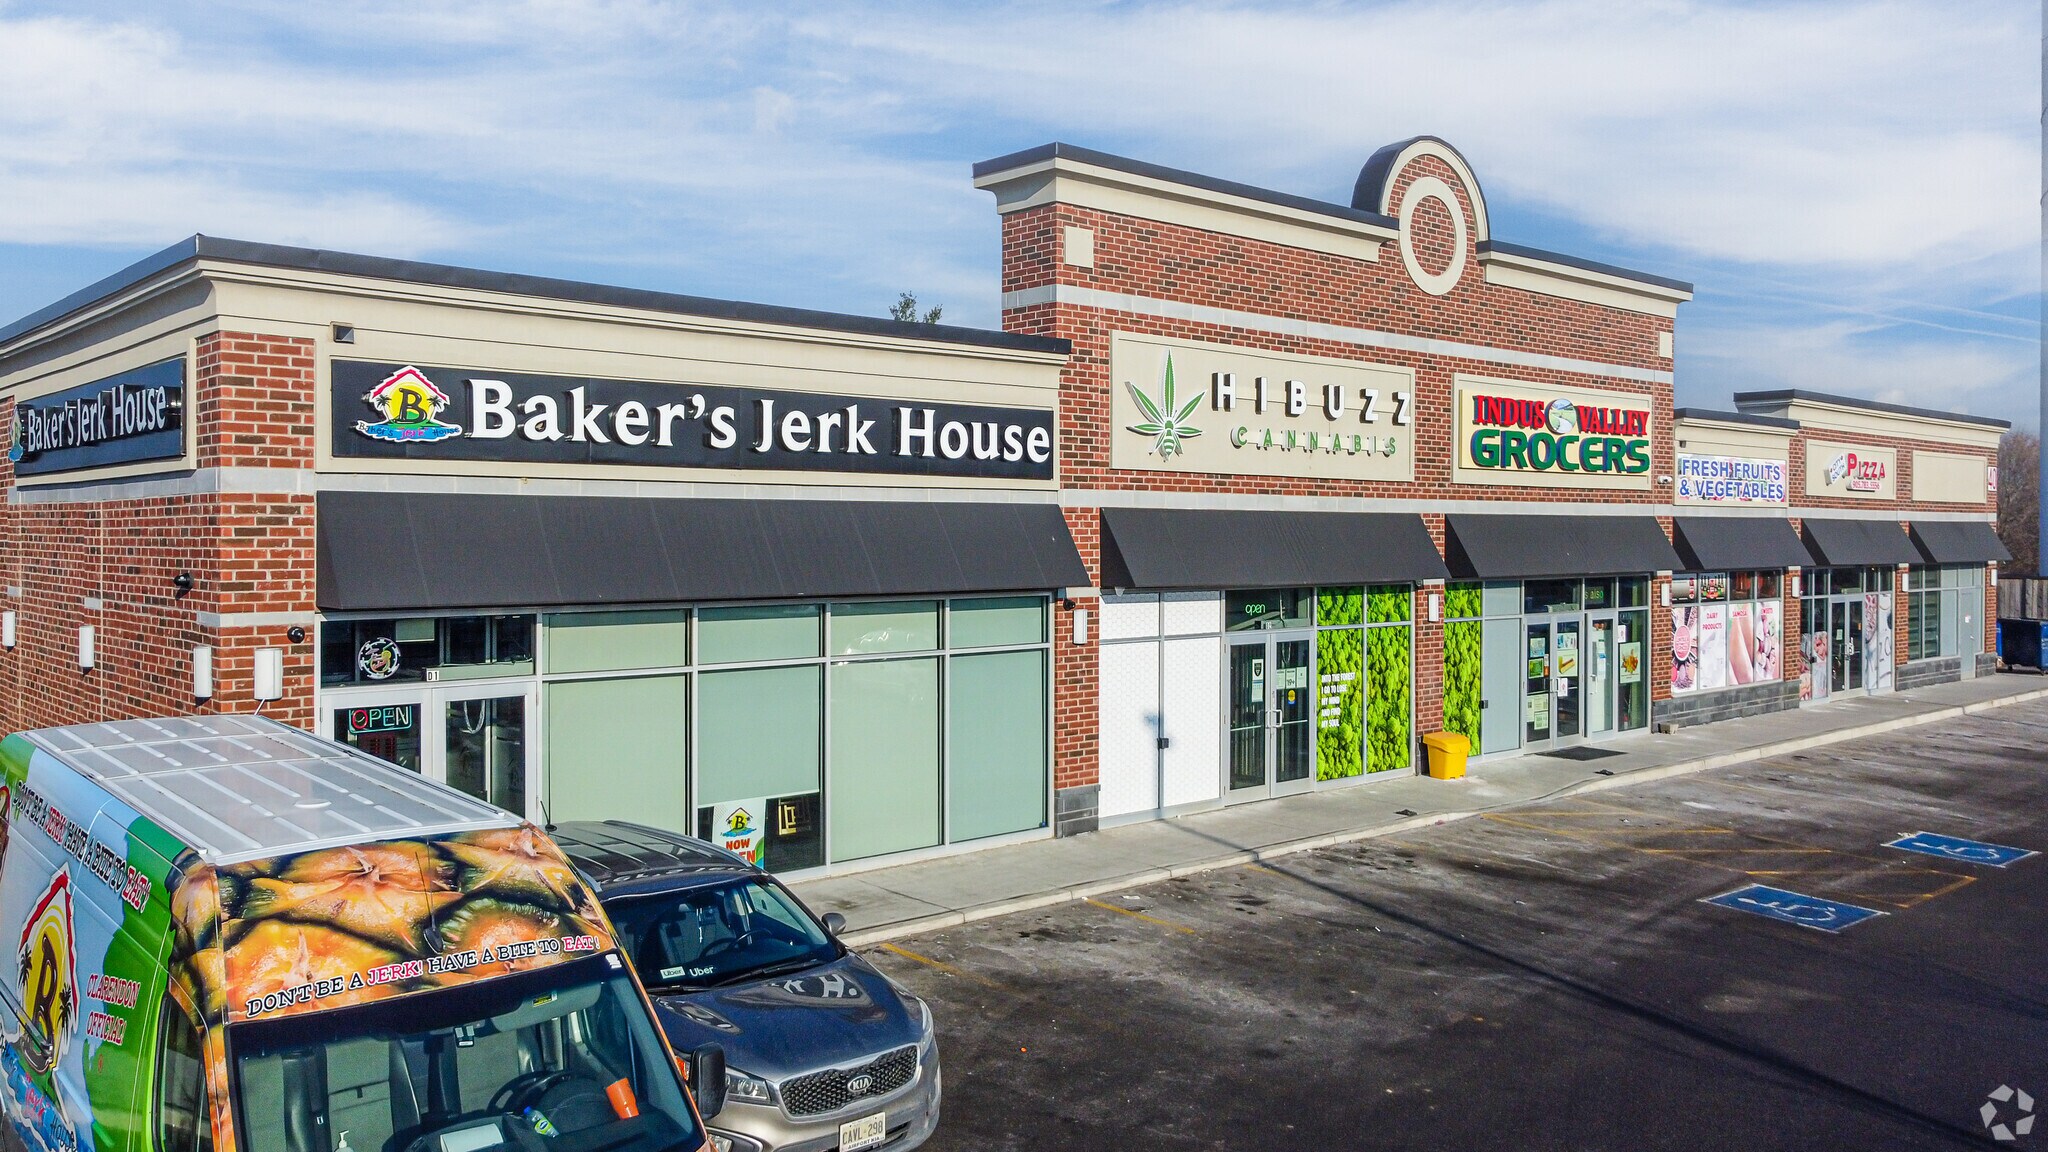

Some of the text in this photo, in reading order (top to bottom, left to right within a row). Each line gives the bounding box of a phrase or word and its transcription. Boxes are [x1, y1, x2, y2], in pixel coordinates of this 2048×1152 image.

[397, 386, 429, 424] B
[1212, 372, 1411, 425] HIBUZZ
[27, 384, 167, 453] Baker's Jerk House
[467, 378, 1051, 463] Baker's Jerk House
[1473, 395, 1650, 437] INDUS VALLEY
[1231, 426, 1396, 456] CANNABIS
[1470, 429, 1650, 473] GROCERS
[1682, 459, 1780, 480] FRESH FRUITS
[1680, 479, 1783, 499] & VEGETABLES
[1245, 603, 1266, 616] open
[352, 706, 409, 730] OPEN
[726, 838, 750, 851] NOW
[109, 855, 127, 893] TO
[246, 936, 601, 1018] DON'T BE A JERK! HAVE A BITE TO EAT!
[662, 968, 683, 978] Uber
[689, 965, 714, 978] Uber
[86, 973, 141, 1009] CLARENDON
[852, 1078, 870, 1091] KIA
[842, 1120, 883, 1145] CAVL 298
[848, 1138, 870, 1150] AIRPORT
